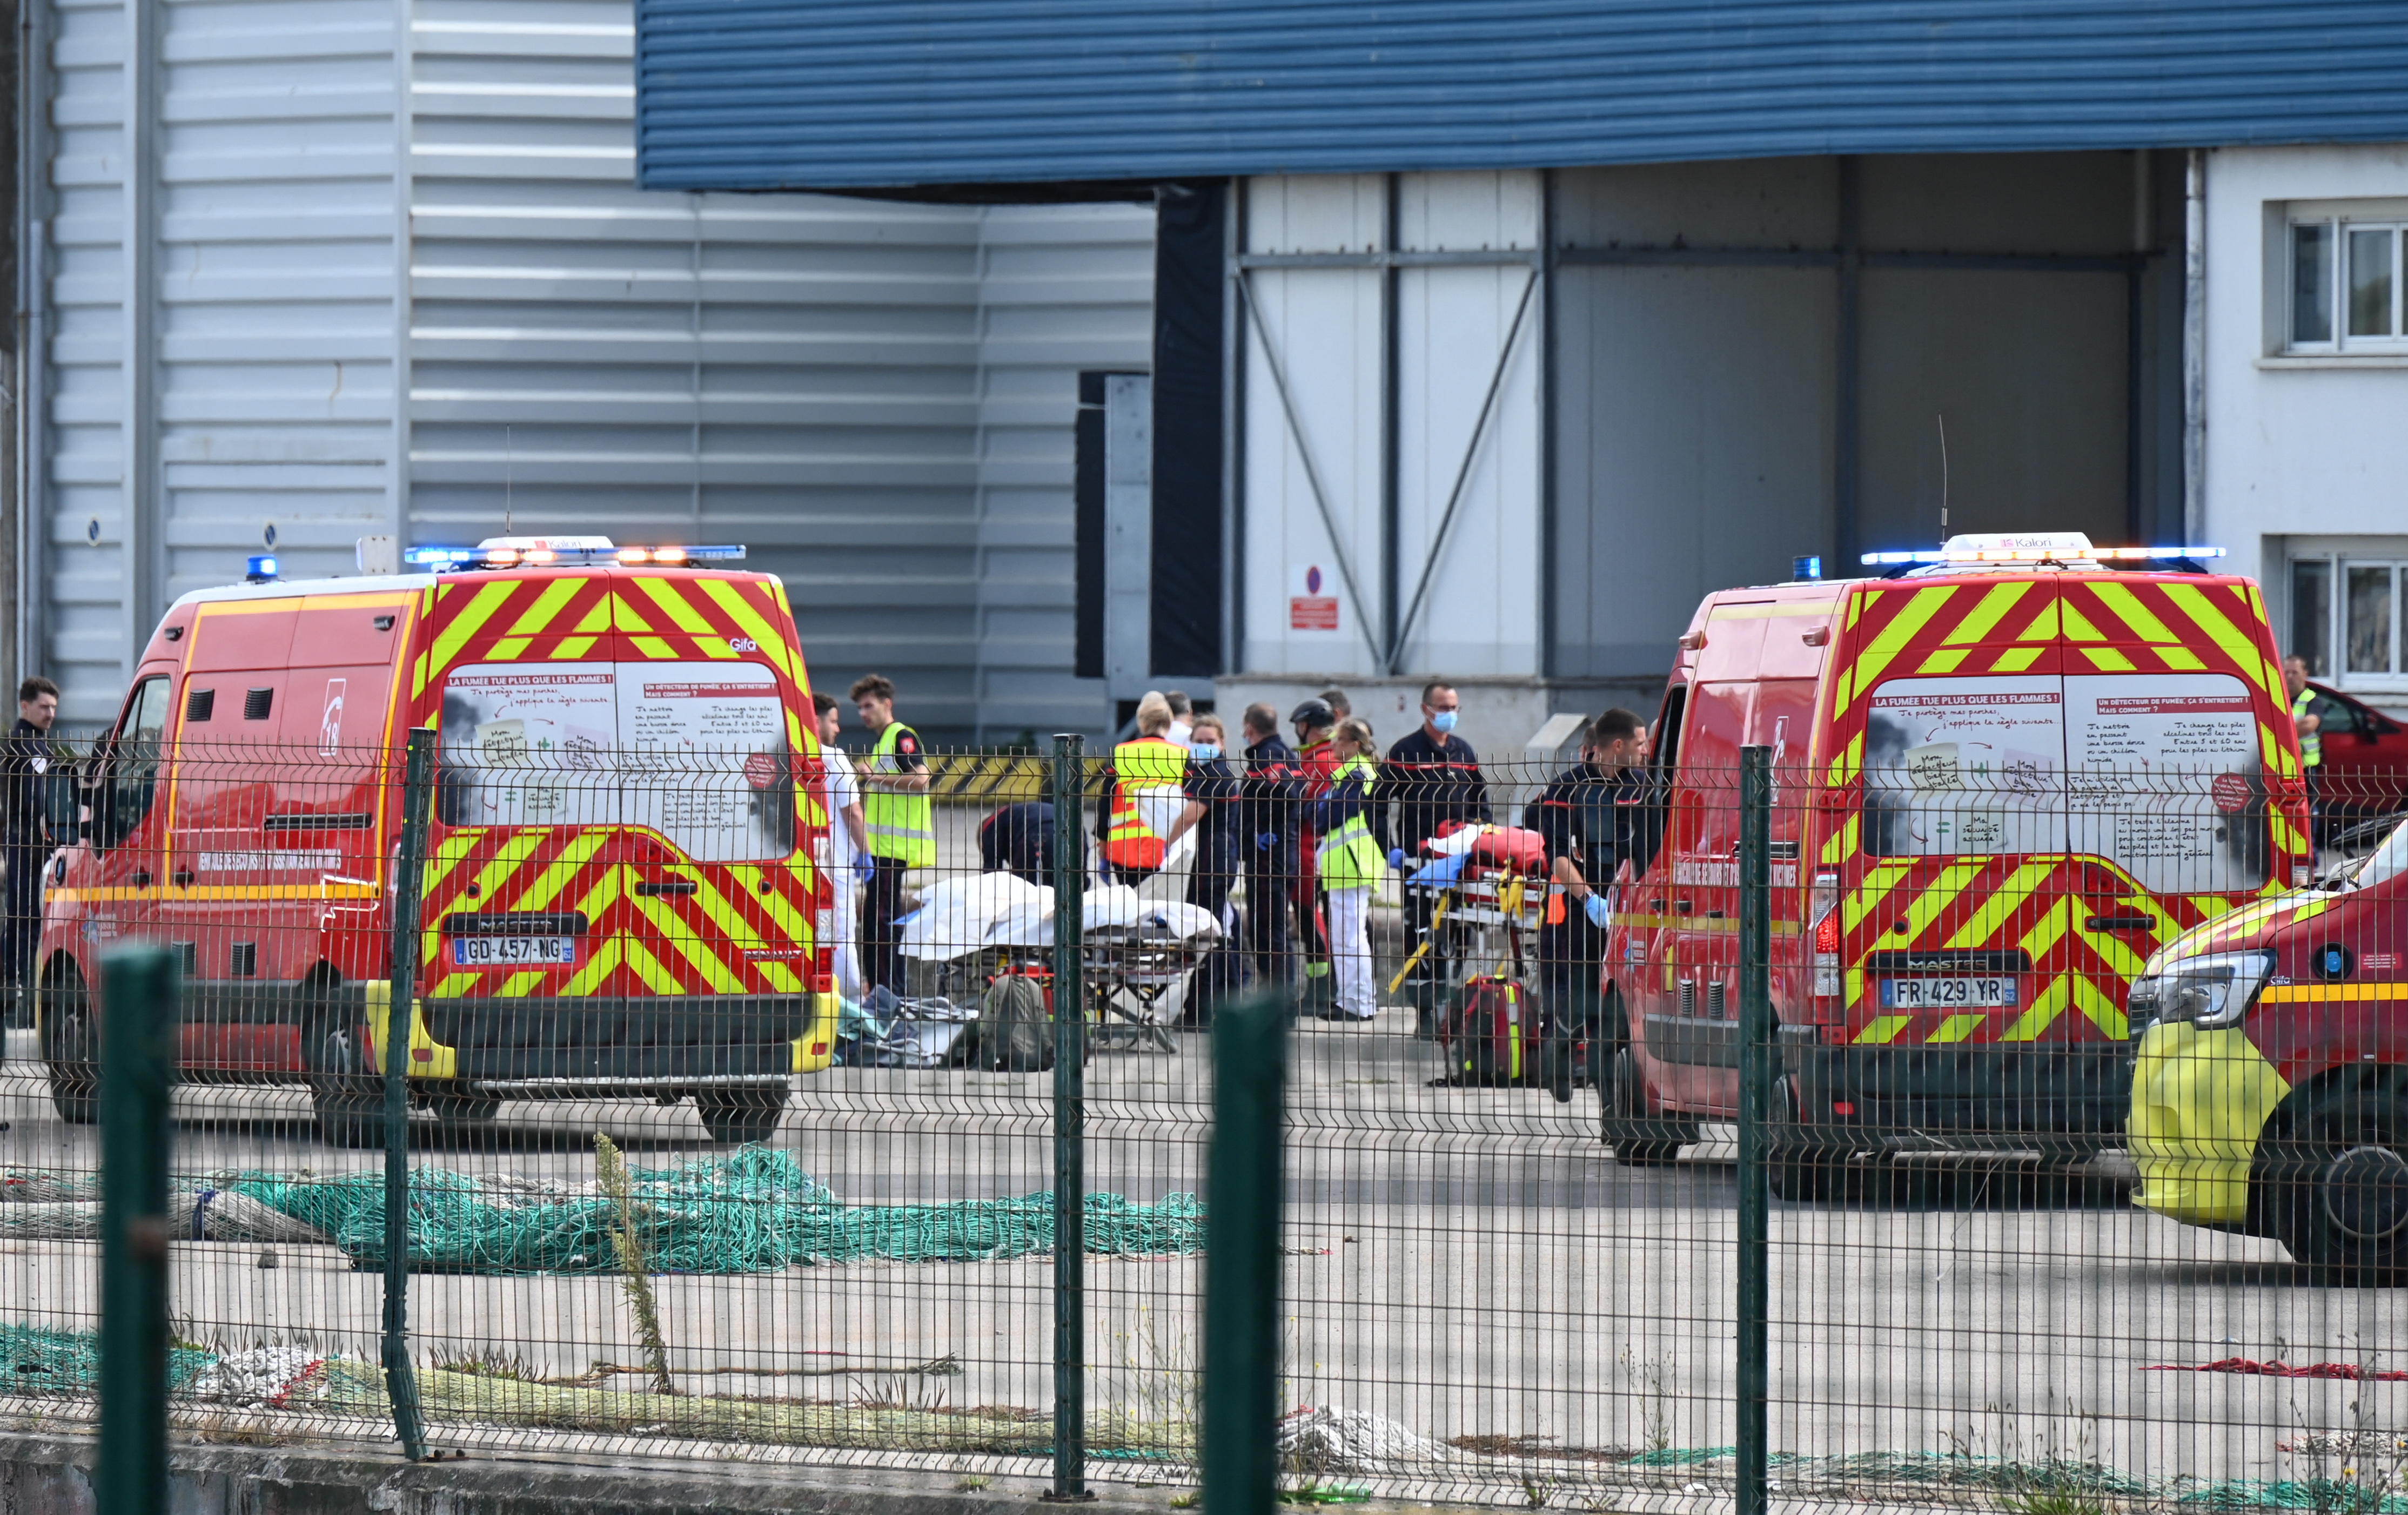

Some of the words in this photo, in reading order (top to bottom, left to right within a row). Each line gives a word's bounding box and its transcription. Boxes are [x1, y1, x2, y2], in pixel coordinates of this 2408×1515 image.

[548, 540, 581, 549] Kalori
[2016, 538, 2051, 547] Kalori
[729, 638, 757, 651] Gifa
[462, 677, 489, 685] FUMÉE
[486, 686, 512, 697] protège
[1876, 698, 1886, 706] LA
[1889, 696, 1919, 705] FUMÉE
[1969, 696, 1988, 704] QUE
[2010, 695, 2052, 703] FLAMMES
[1916, 708, 1946, 719] protège
[1943, 719, 1981, 731] j'applique
[1997, 717, 2018, 729] règle
[2190, 723, 2215, 732] change
[2231, 722, 2245, 730] piles
[326, 722, 338, 751] 18
[2100, 732, 2127, 740] passant
[2192, 747, 2206, 756] piles
[481, 920, 553, 930] MASTER
[468, 939, 560, 959] GD-457-NG
[564, 950, 572, 959] 62
[742, 950, 802, 959] RENAULT
[1908, 959, 1987, 969] MASTER
[2271, 975, 2291, 984] Gifa
[1897, 980, 2000, 1002] FR-429-YR
[2004, 992, 2015, 1002] 62
